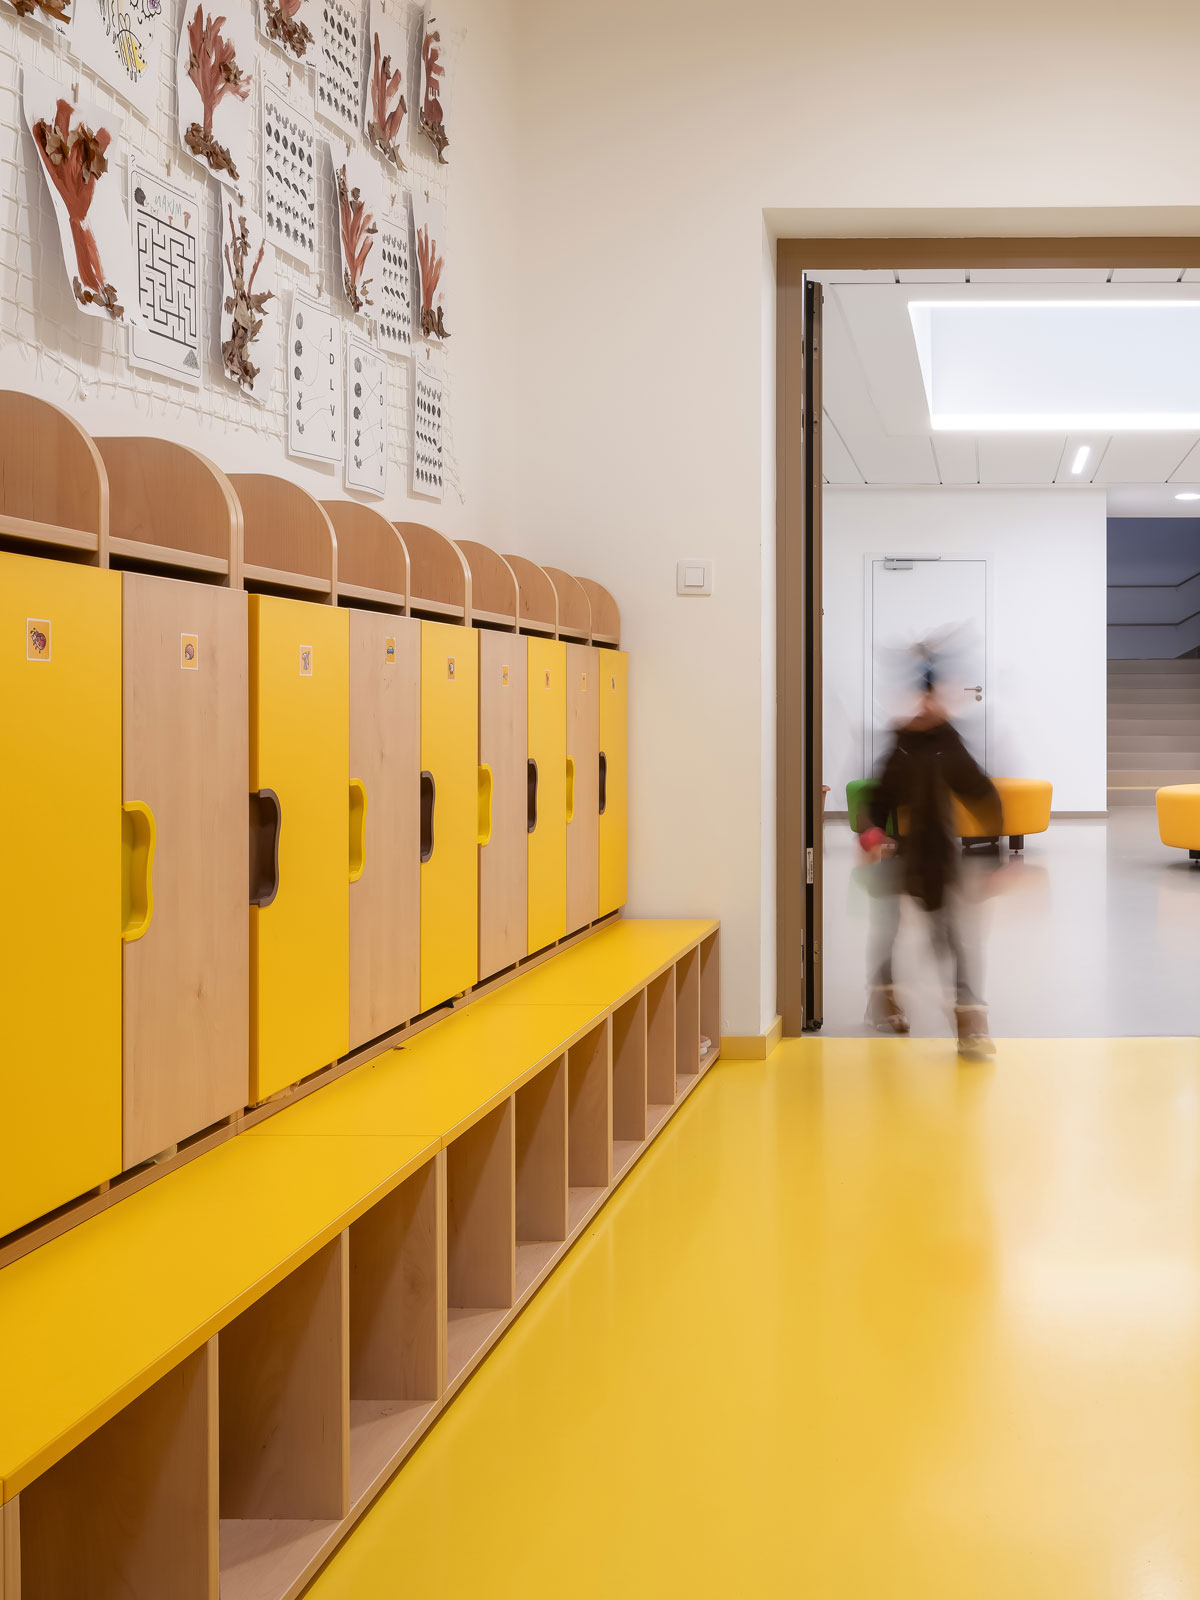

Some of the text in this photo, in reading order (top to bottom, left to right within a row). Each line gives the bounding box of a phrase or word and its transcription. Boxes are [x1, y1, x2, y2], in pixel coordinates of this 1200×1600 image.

[330, 353, 334, 365] D
[330, 405, 335, 416] V
[331, 430, 336, 442] K
